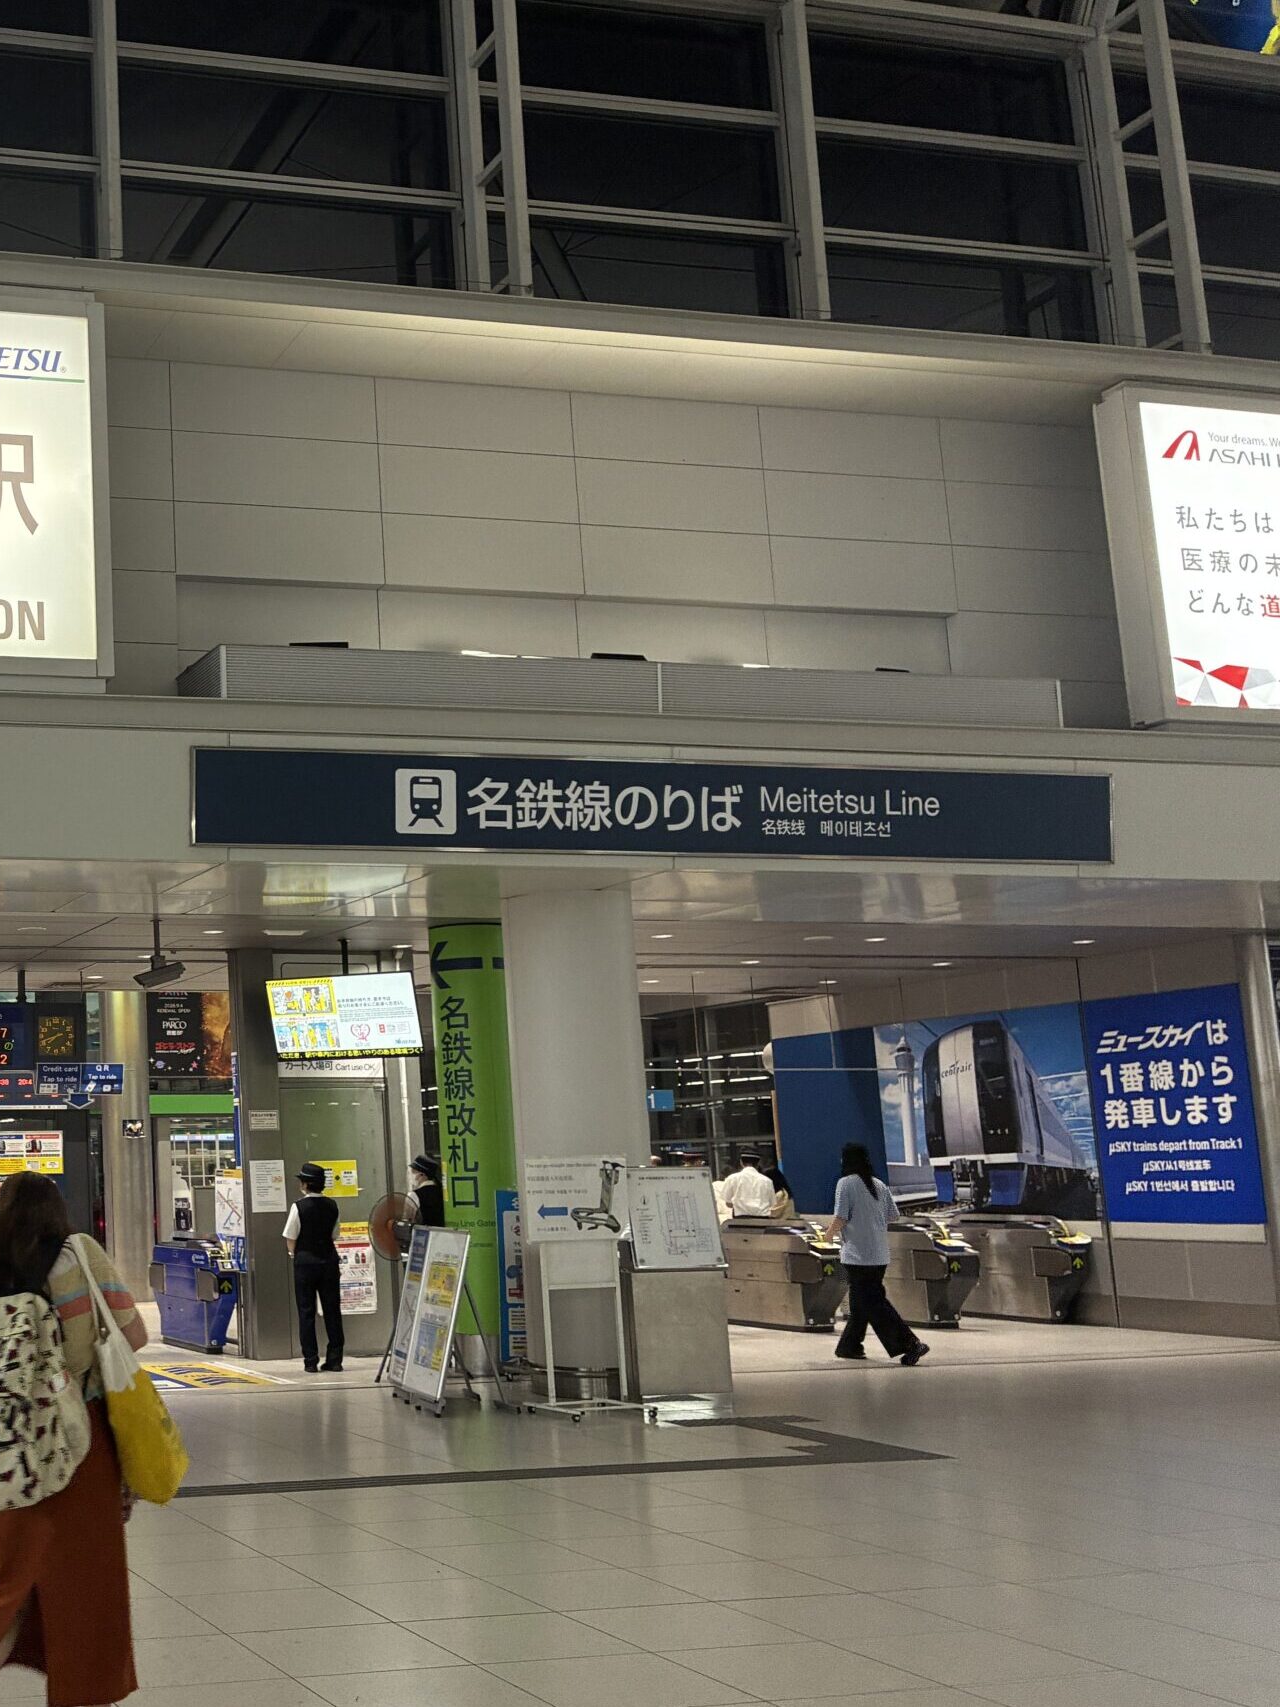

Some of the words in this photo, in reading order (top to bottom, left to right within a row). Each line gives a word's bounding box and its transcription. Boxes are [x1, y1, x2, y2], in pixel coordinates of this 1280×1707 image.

[1208, 431, 1229, 443] Your
[1208, 448, 1271, 467] ASAHI
[1176, 505, 1274, 534] 私たちは
[467, 778, 743, 832] 名鉄線のりば
[760, 786, 875, 815] Meitetsu
[885, 790, 940, 817] Line
[762, 818, 806, 837] 名铁线
[820, 822, 892, 838] 메이테츠선
[162, 1021, 187, 1029] PARCO
[1097, 1019, 1230, 1054] ミュースカイは
[285, 1061, 333, 1070] カート入場可
[335, 1063, 350, 1071] Cart
[1100, 1055, 1234, 1094] 1番線から
[439, 995, 480, 1210] 名鉄線改札口
[647, 1093, 655, 1108] 1
[1103, 1093, 1238, 1130] 発車します
[1133, 1141, 1158, 1152] trains
[1158, 1139, 1187, 1153] depart
[1188, 1139, 1210, 1151] from
[1210, 1138, 1237, 1150] Track
[1237, 1138, 1243, 1149] 1
